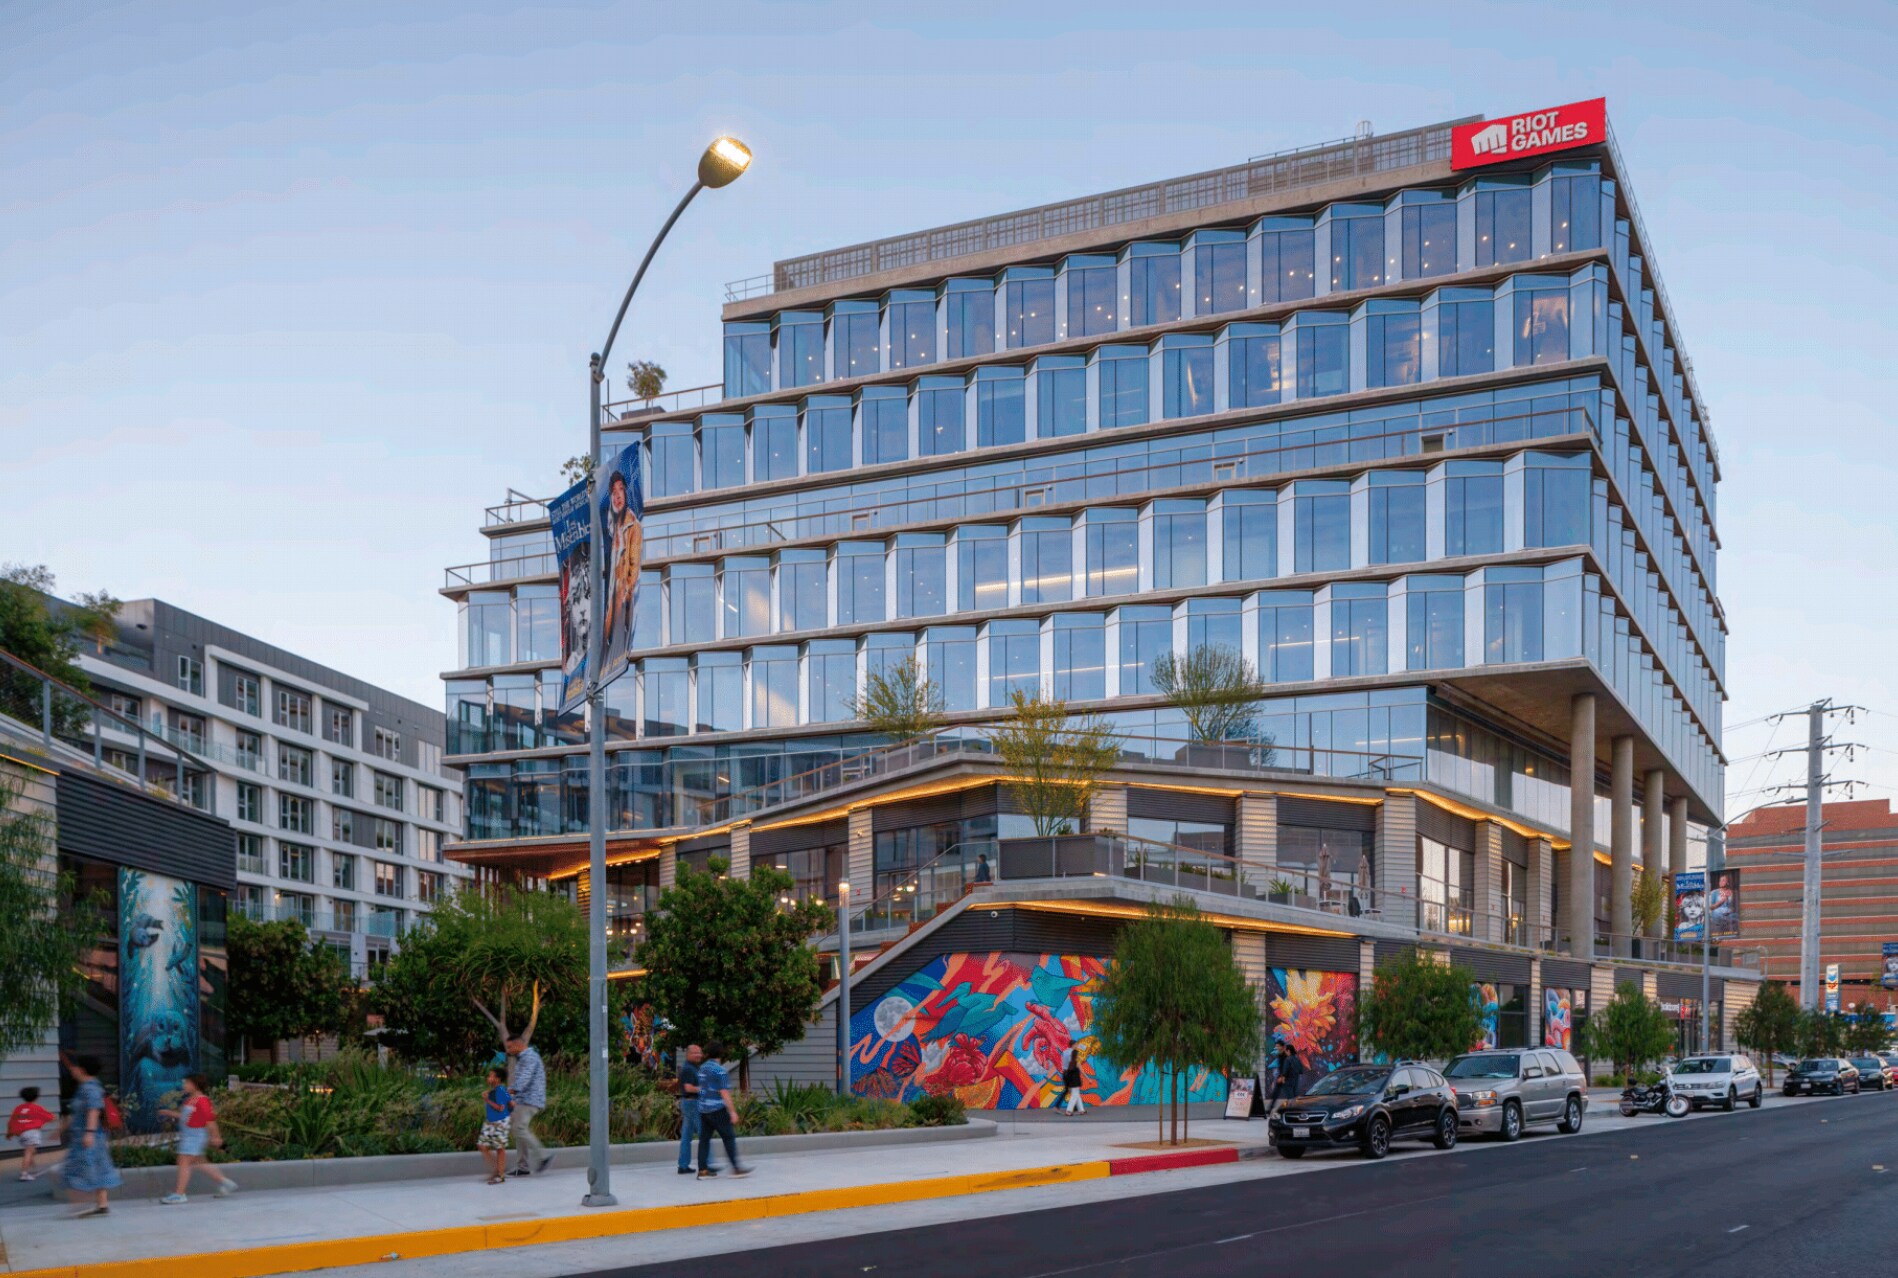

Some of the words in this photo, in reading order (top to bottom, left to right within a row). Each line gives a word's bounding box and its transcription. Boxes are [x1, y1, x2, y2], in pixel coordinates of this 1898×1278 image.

[1511, 111, 1559, 135] RIOT
[1511, 121, 1588, 151] GAMES
[555, 520, 590, 553] Misérable
